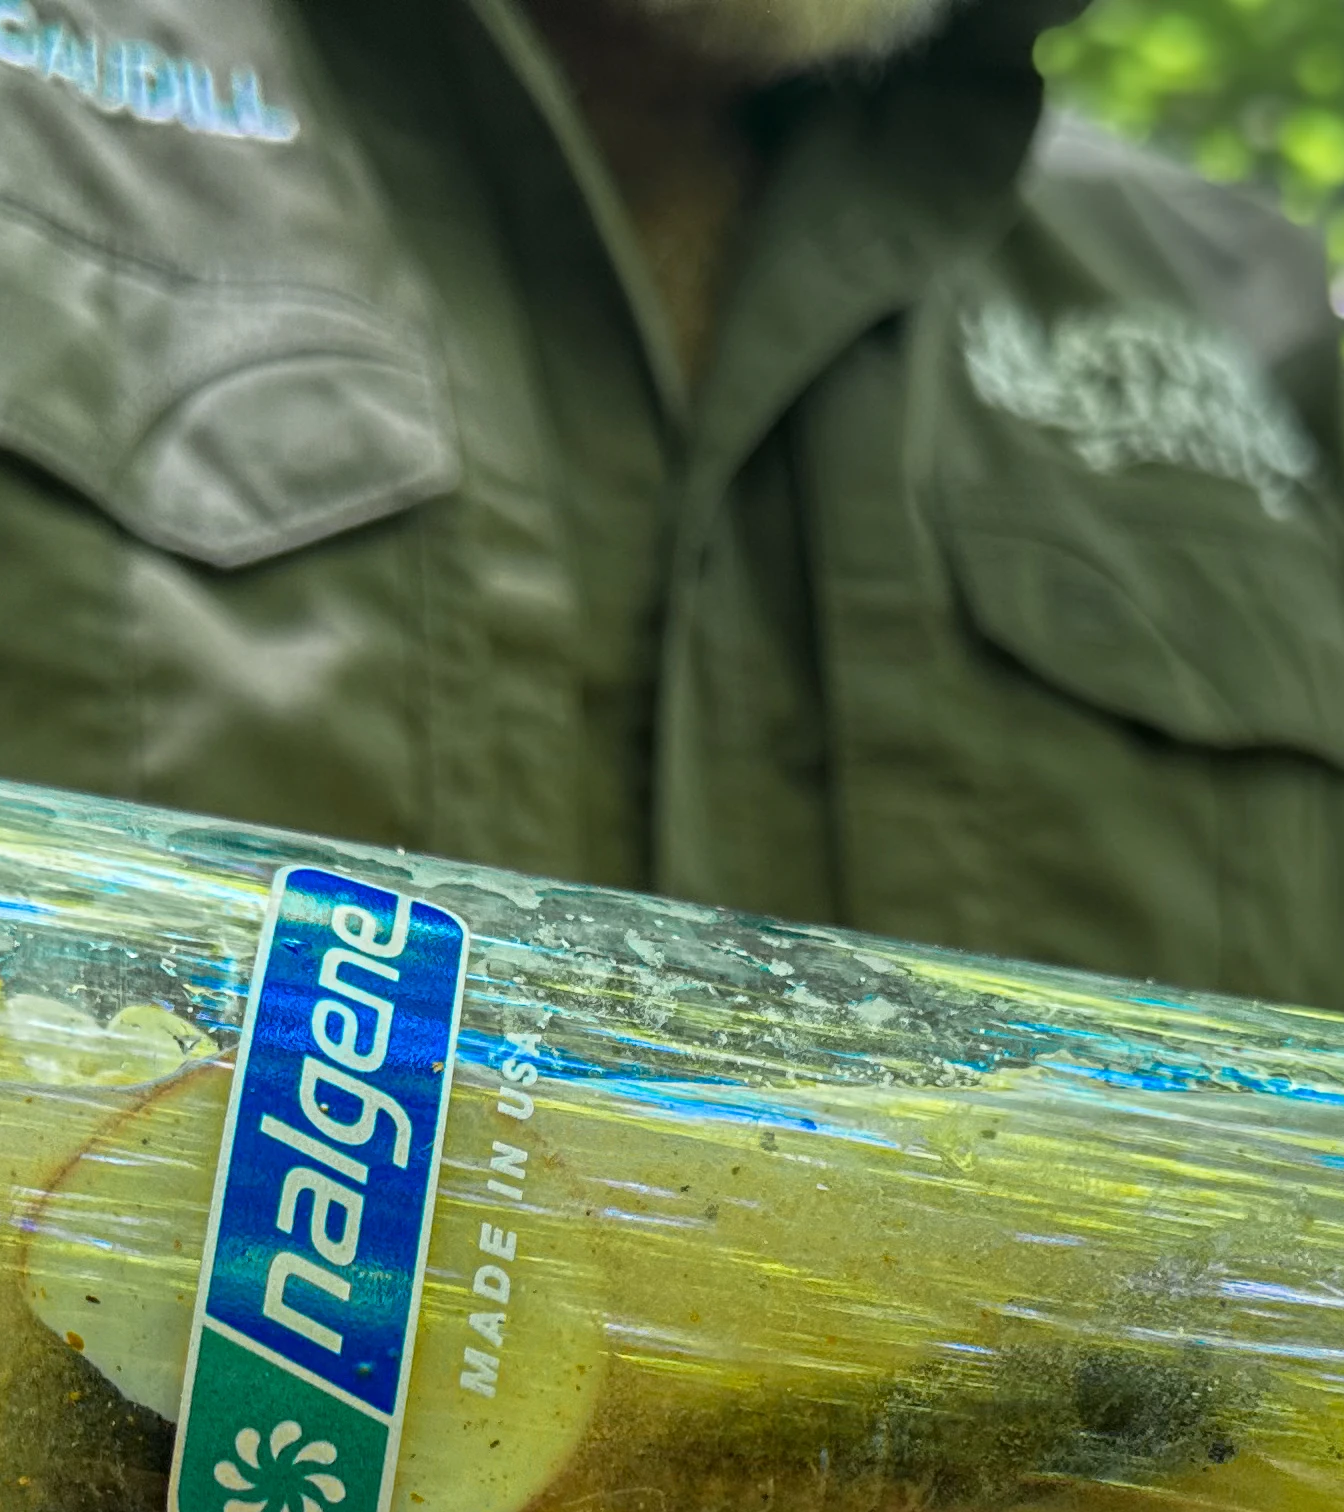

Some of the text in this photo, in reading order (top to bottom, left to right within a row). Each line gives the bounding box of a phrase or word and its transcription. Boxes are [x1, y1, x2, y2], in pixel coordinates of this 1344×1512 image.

[260, 893, 413, 1355] nalgene
[460, 1031, 542, 1398] MADE IN USA
